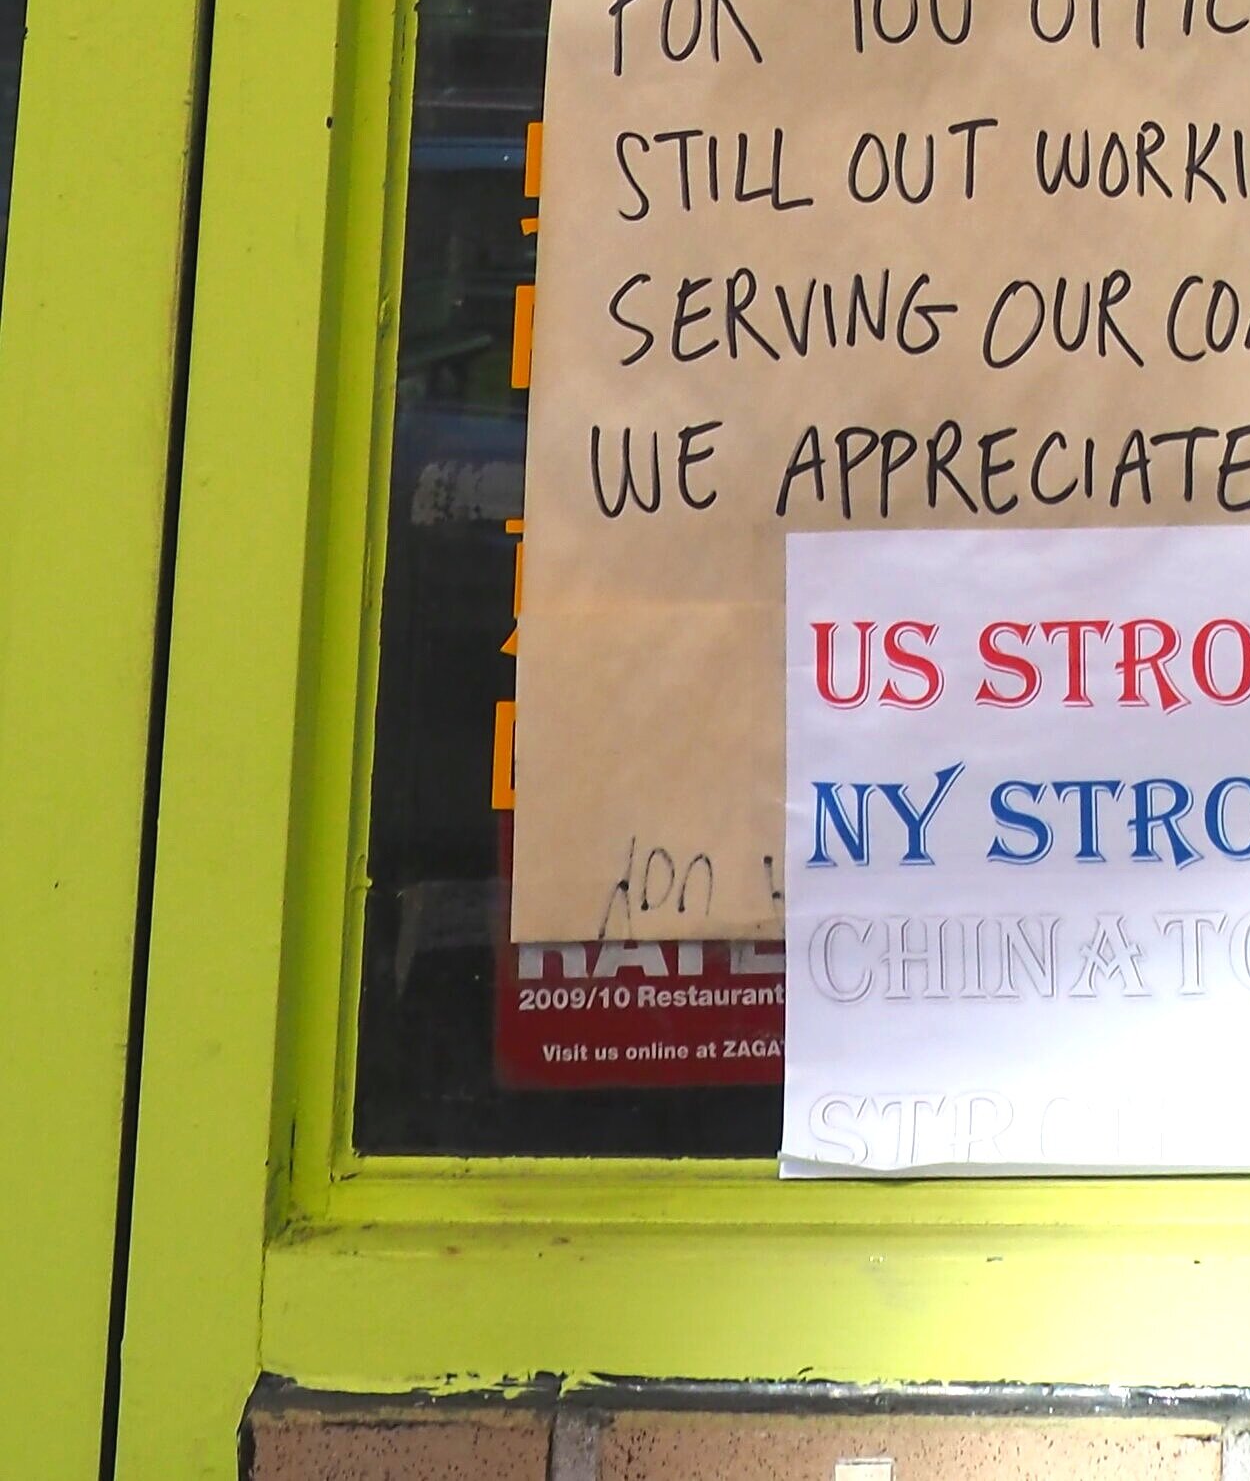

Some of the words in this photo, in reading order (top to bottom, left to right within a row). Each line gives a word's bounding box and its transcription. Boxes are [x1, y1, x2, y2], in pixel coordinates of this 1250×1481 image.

[617, 128, 813, 220] STILL
[849, 119, 998, 203] OUT
[610, 268, 958, 365] SERVING
[983, 270, 1144, 368] OUR
[592, 422, 722, 518] WE
[810, 619, 944, 711] US
[806, 761, 965, 868] NY
[519, 987, 630, 1011] 2009/10
[637, 984, 785, 1008] Restaurant
[542, 1044, 588, 1062] Visit
[594, 1046, 618, 1060] us
[625, 1041, 688, 1060] online
[696, 1041, 716, 1058] at
[723, 1039, 785, 1058] ZAGA
